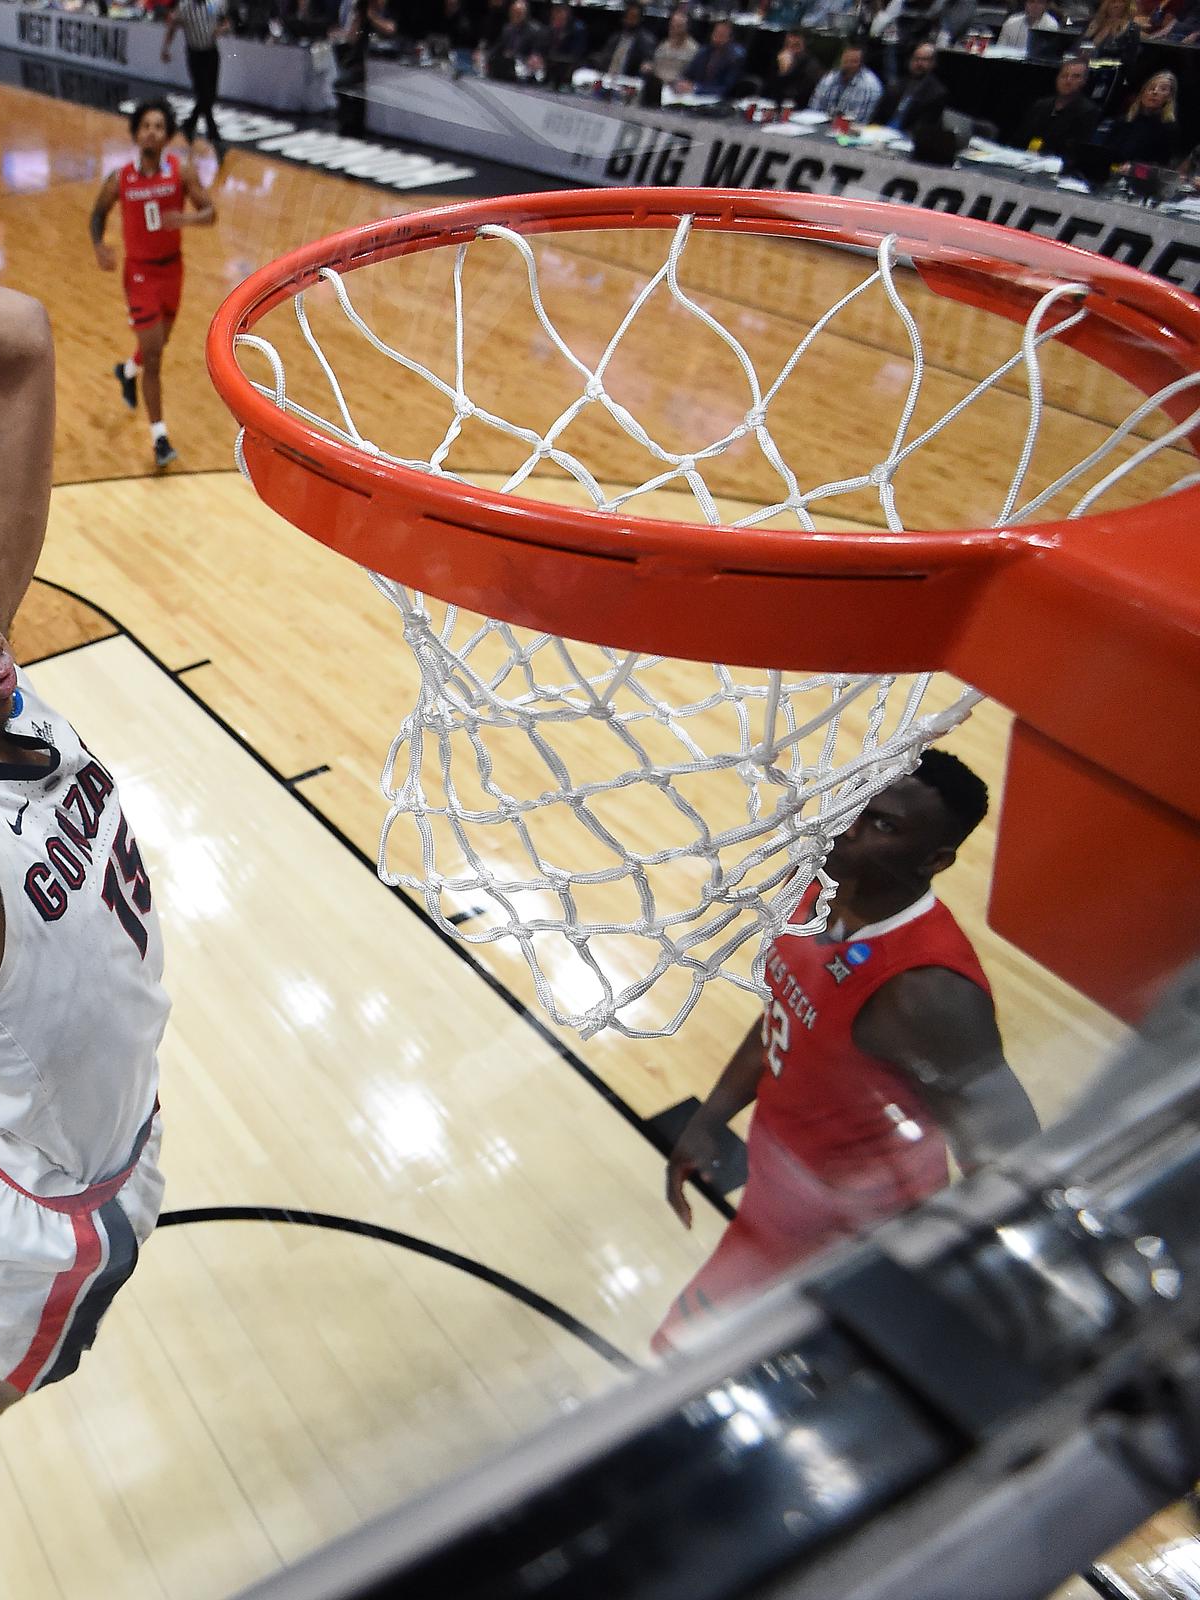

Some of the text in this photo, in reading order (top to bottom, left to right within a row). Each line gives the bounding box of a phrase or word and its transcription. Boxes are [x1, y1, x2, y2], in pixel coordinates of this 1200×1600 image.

[17, 11, 129, 66] WEST REGIONAL
[604, 119, 694, 186] BIG
[143, 201, 162, 233] 0
[101, 808, 152, 961] 15
[782, 973, 818, 1031] TECH
[760, 998, 790, 1078] 2
